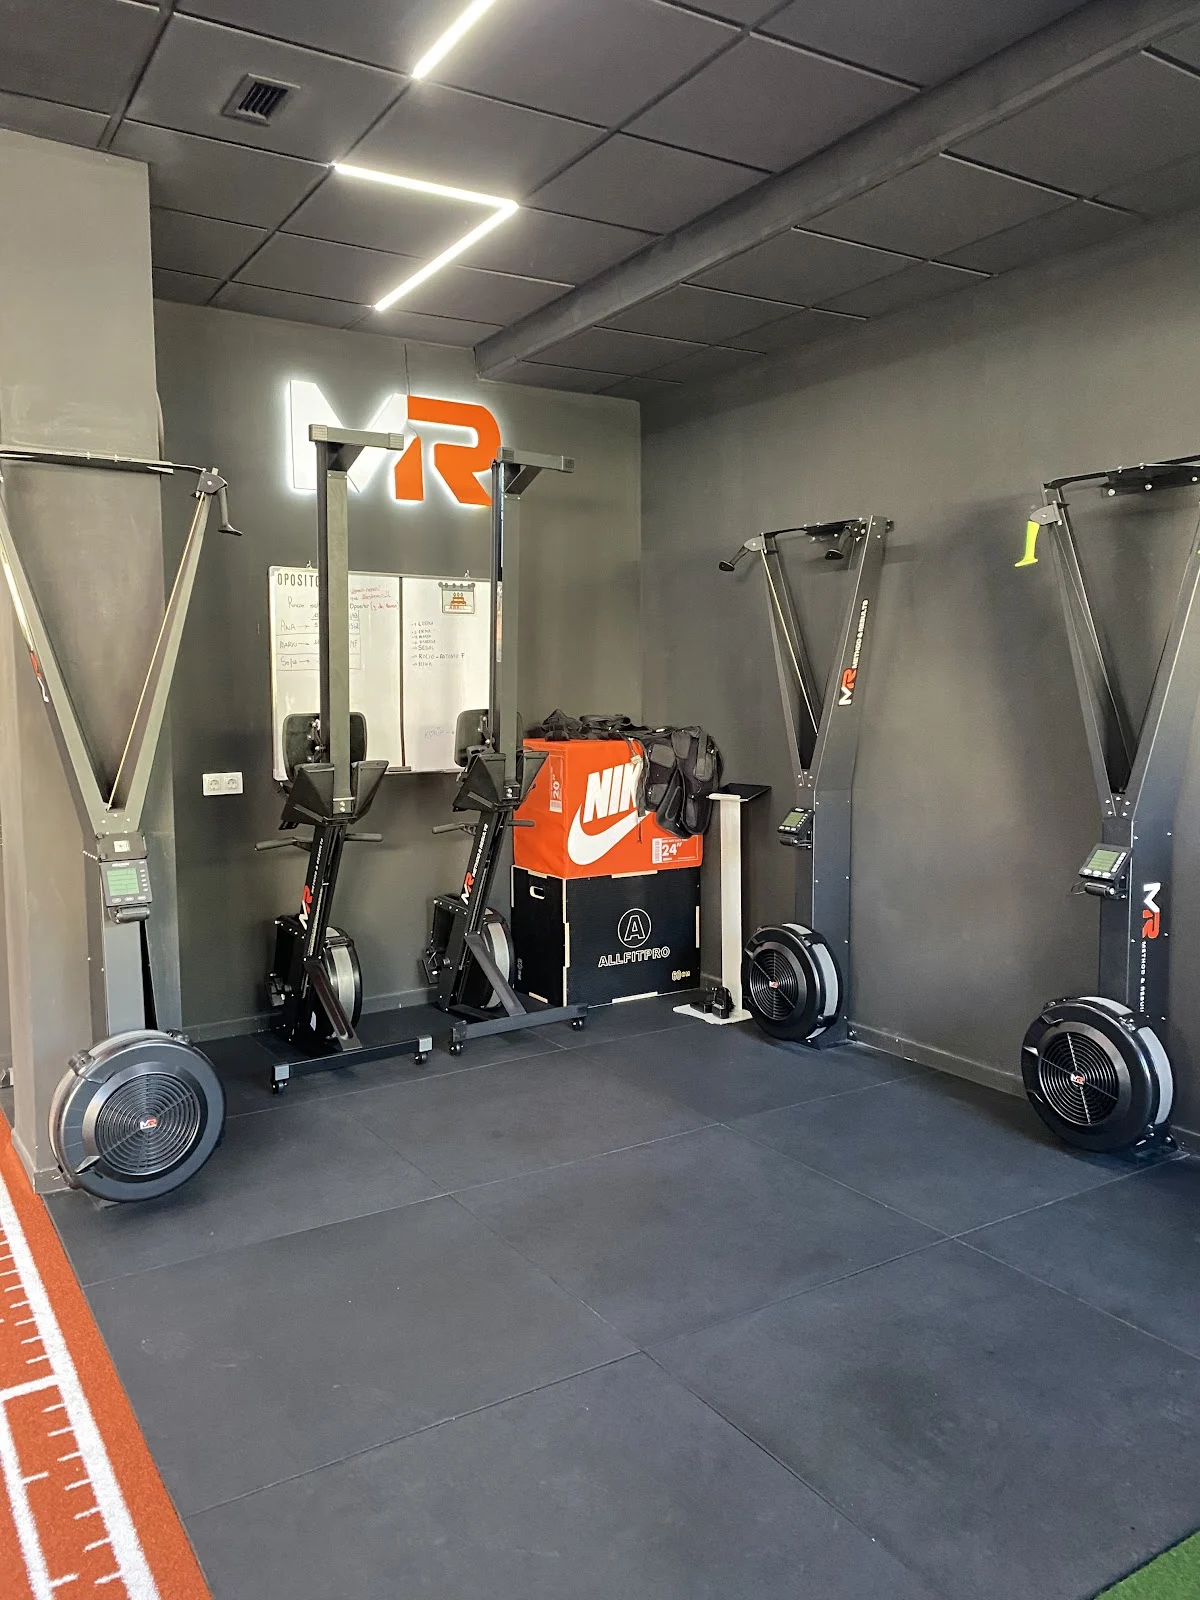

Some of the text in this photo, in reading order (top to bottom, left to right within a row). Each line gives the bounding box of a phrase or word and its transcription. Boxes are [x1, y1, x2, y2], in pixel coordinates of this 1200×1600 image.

[839, 668, 857, 706] MR
[582, 759, 645, 824] NIK
[1142, 882, 1161, 939] MR
[598, 946, 671, 968] ALLFITPRO
